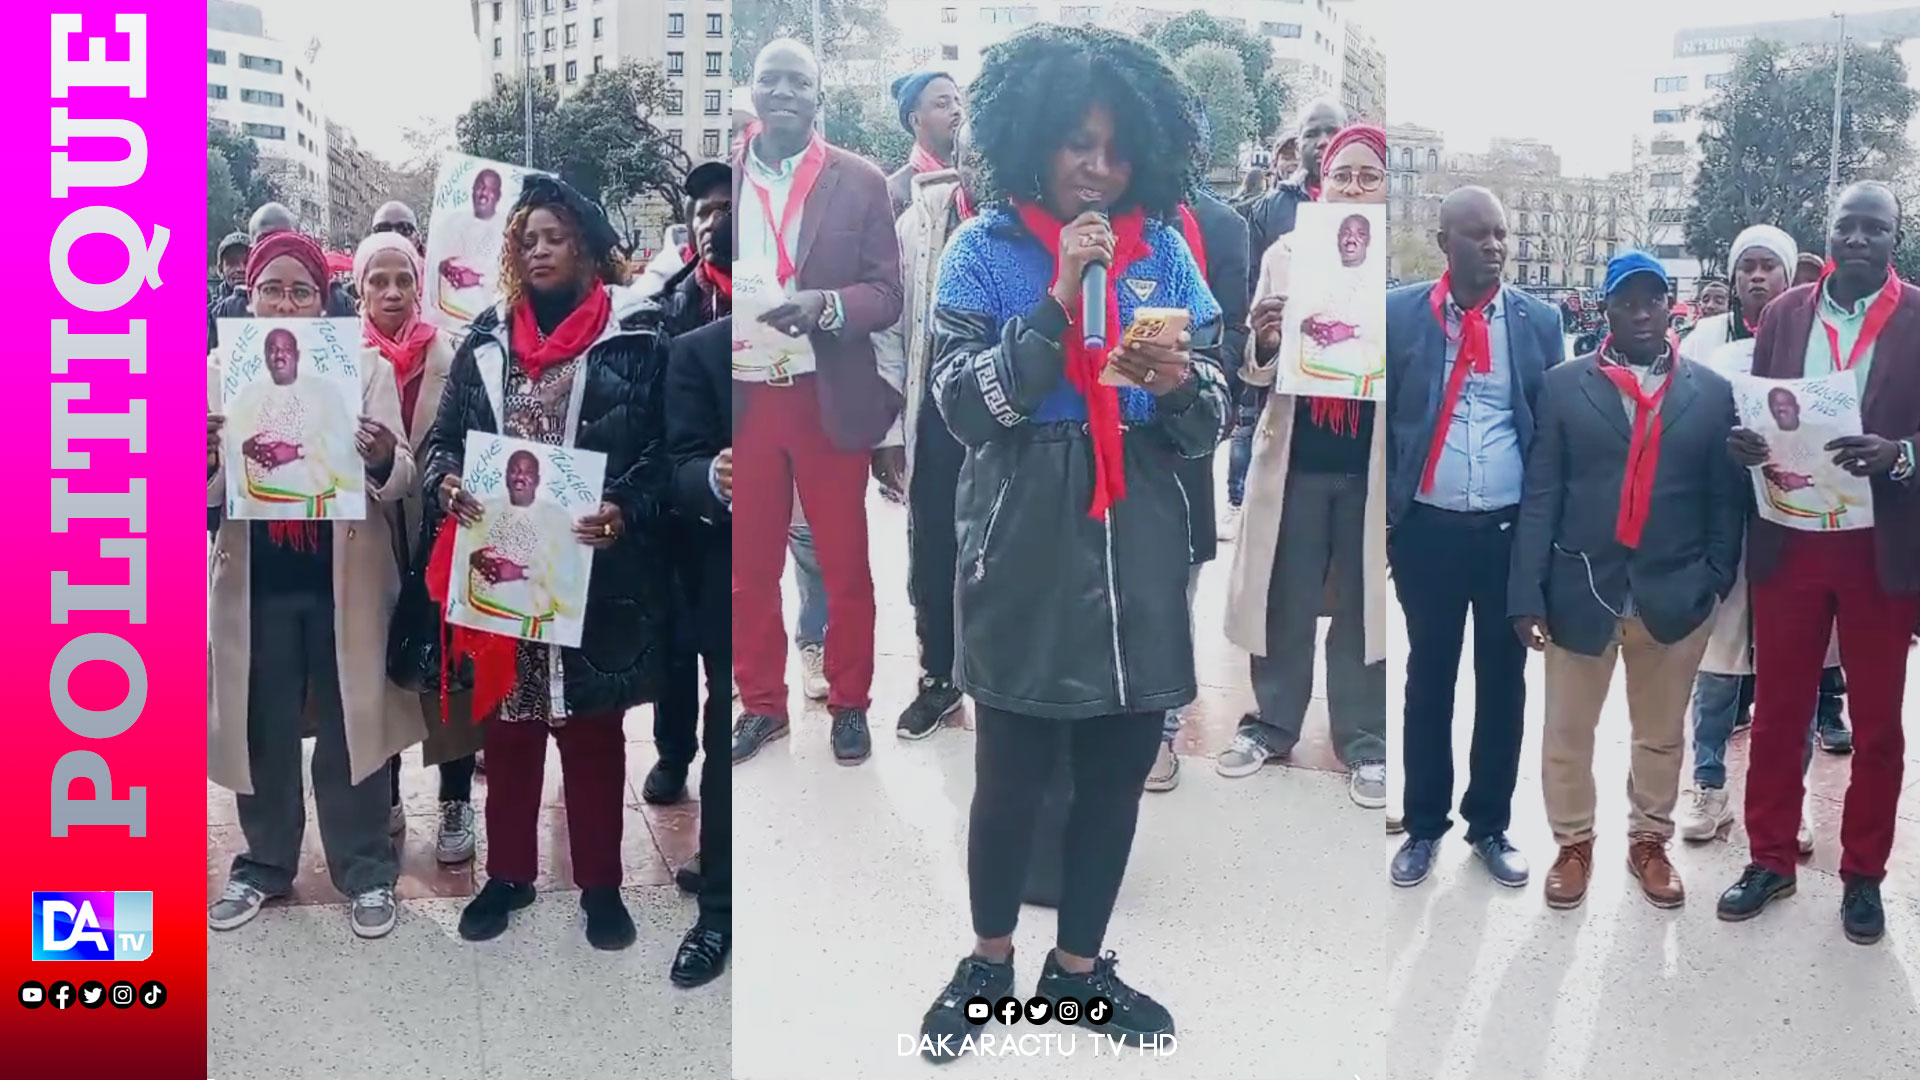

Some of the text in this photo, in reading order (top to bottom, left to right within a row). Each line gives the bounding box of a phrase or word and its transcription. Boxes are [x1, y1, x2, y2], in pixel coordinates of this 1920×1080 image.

[223, 323, 260, 403] TOUCHE
[242, 354, 263, 382] PAS
[312, 319, 357, 378] TOUCHE
[463, 440, 503, 495] OUCHE
[547, 447, 596, 504] TOUCHE
